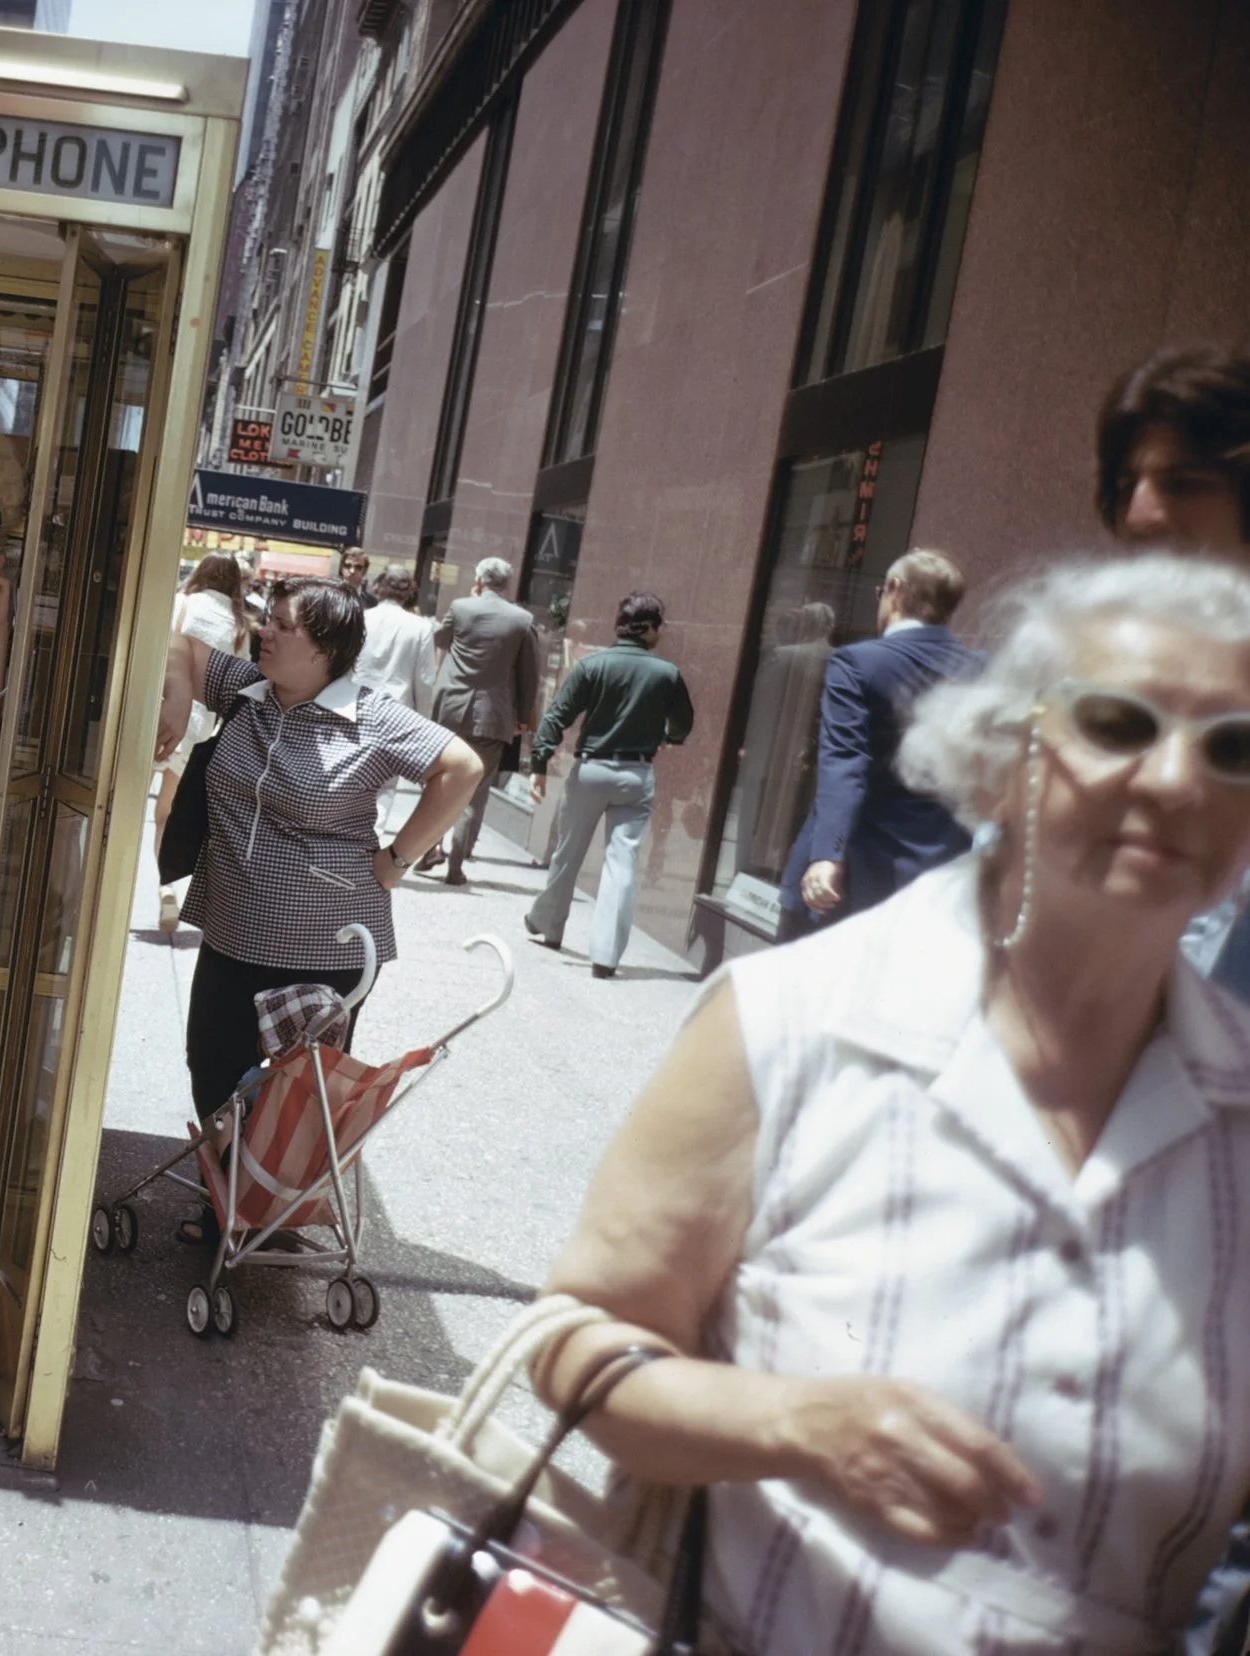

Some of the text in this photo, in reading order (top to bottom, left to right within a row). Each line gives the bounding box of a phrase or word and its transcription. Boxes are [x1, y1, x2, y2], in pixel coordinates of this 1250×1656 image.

[305, 255, 325, 332] ADVANCE
[281, 437, 326, 450] MARINE
[189, 472, 289, 516] American Bank
[190, 504, 348, 536] TRUST COMPANY BUILDING
